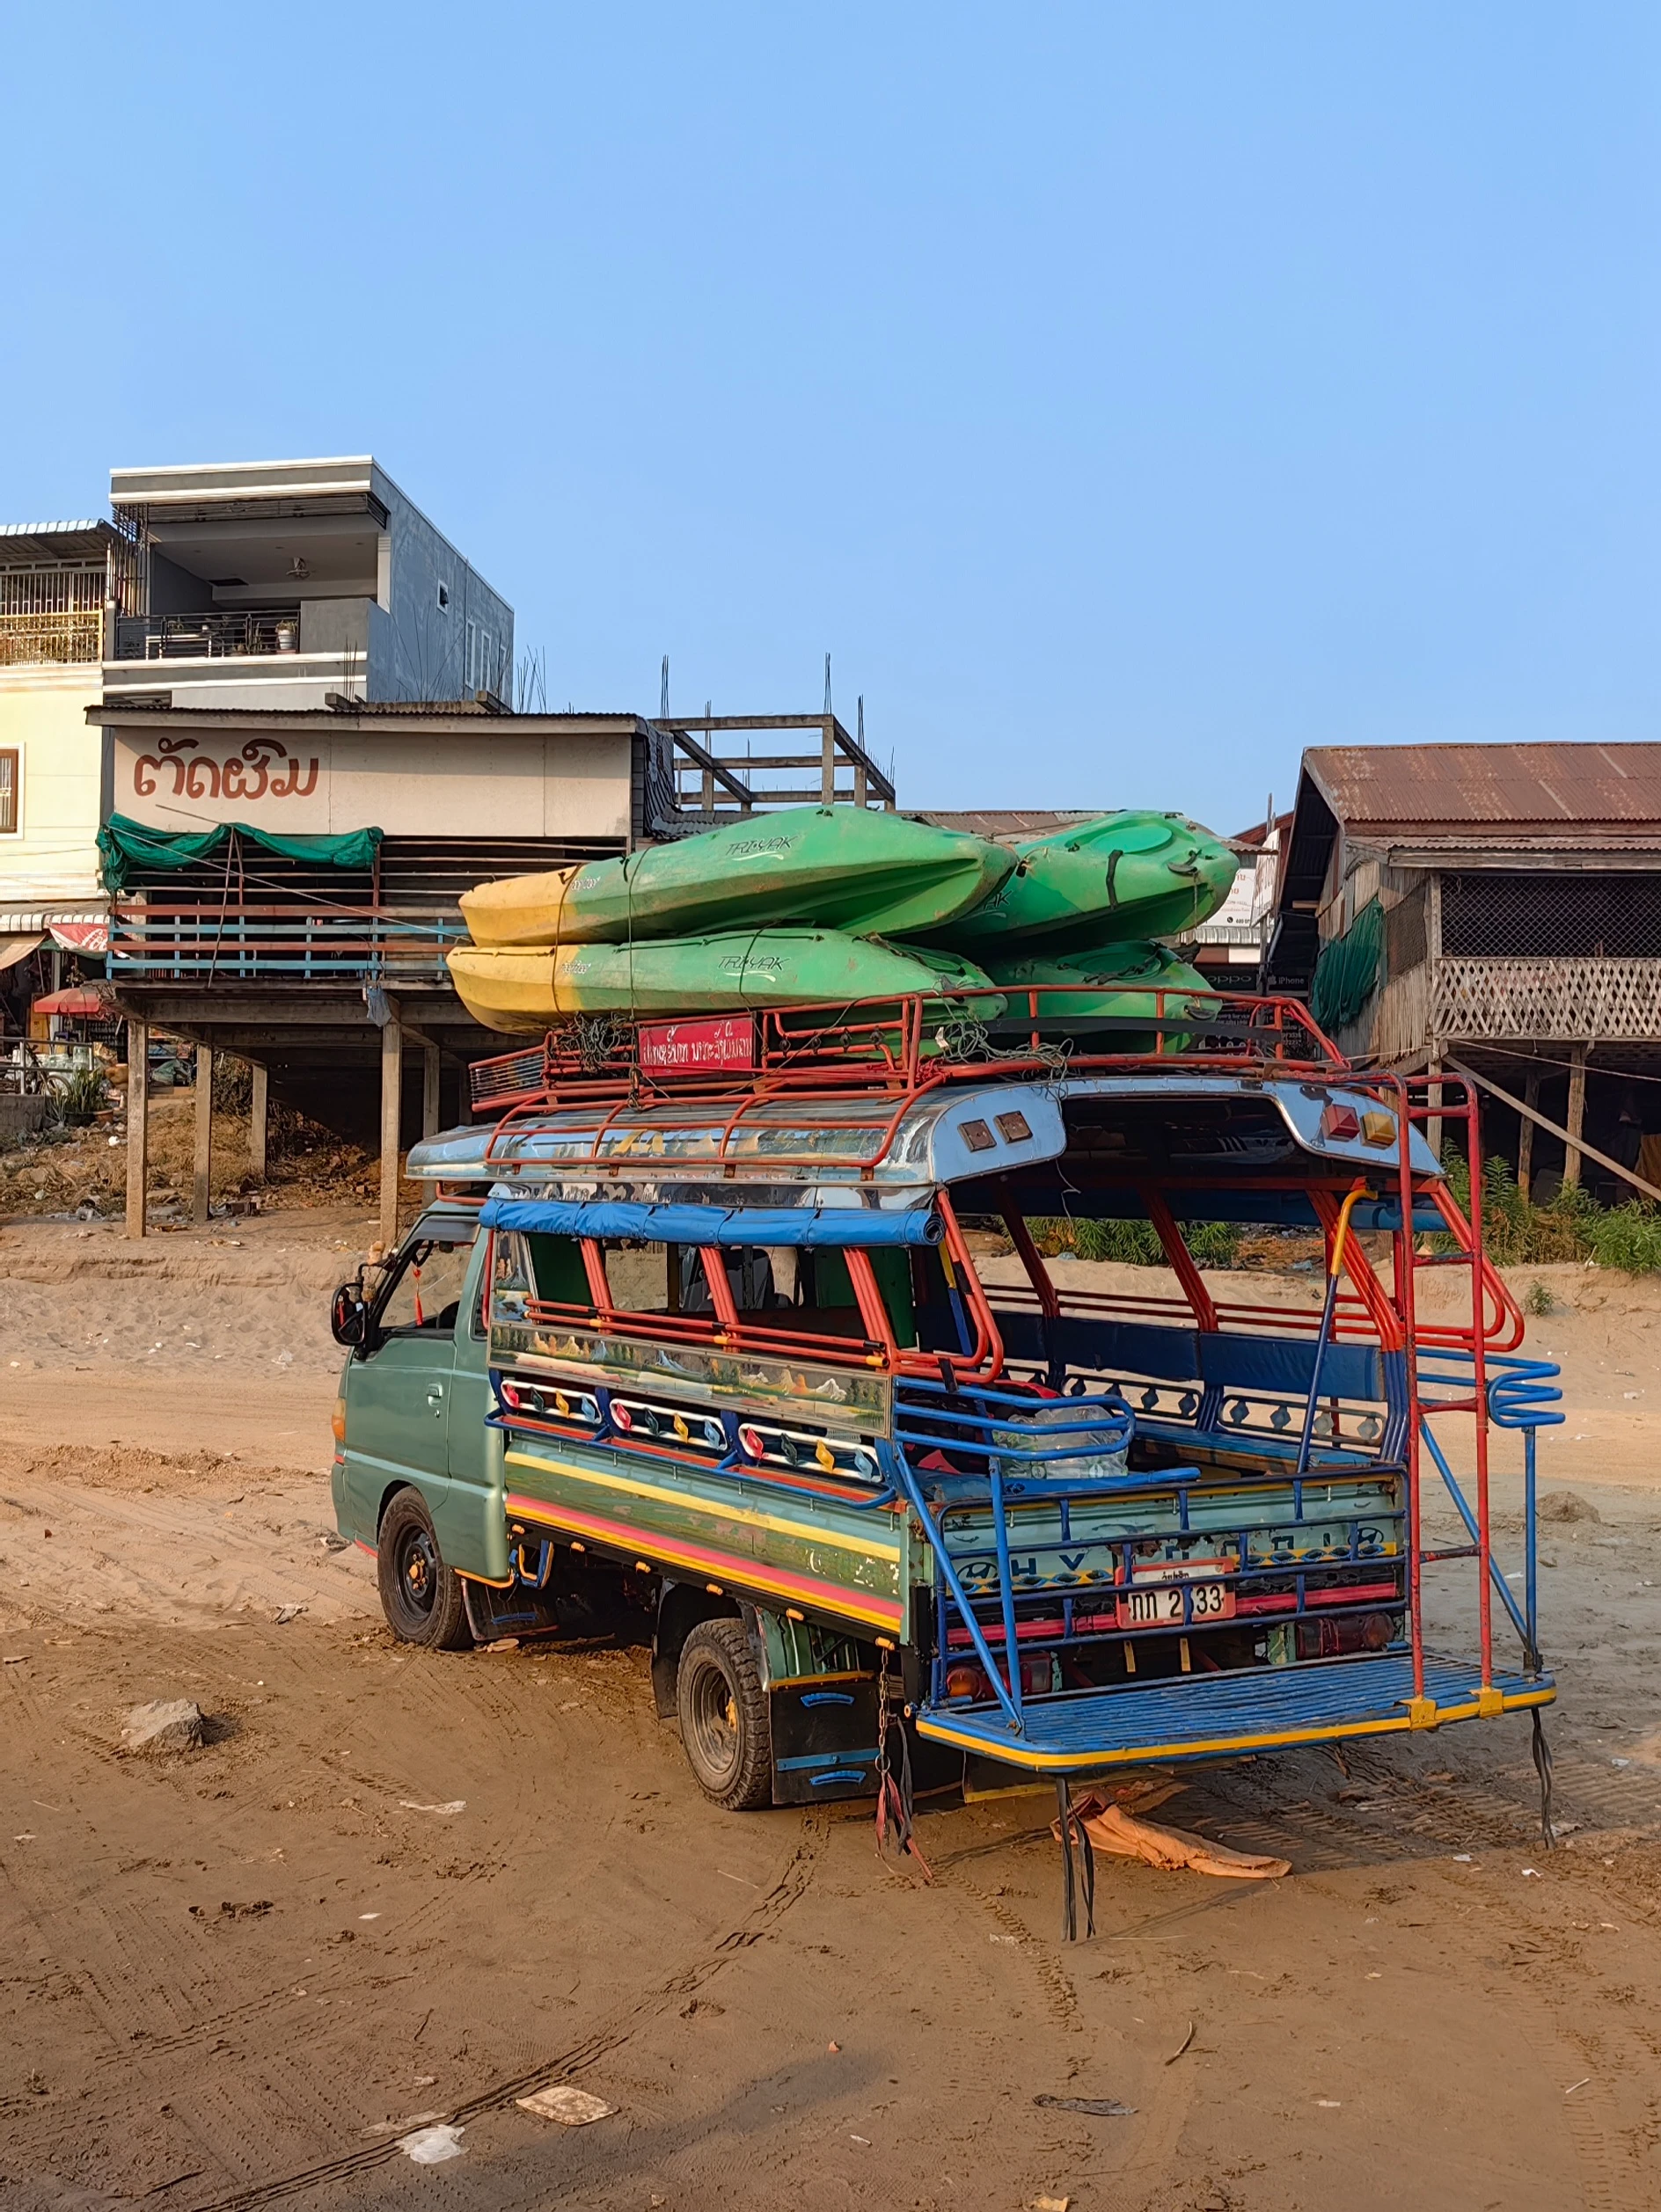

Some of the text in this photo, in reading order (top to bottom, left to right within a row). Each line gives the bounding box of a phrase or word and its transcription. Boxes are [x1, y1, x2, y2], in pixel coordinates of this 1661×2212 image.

[134, 737, 319, 800] ຕັດຜົມ
[1278, 976, 1305, 985] iPhone
[1168, 1585, 1222, 1617] 233
